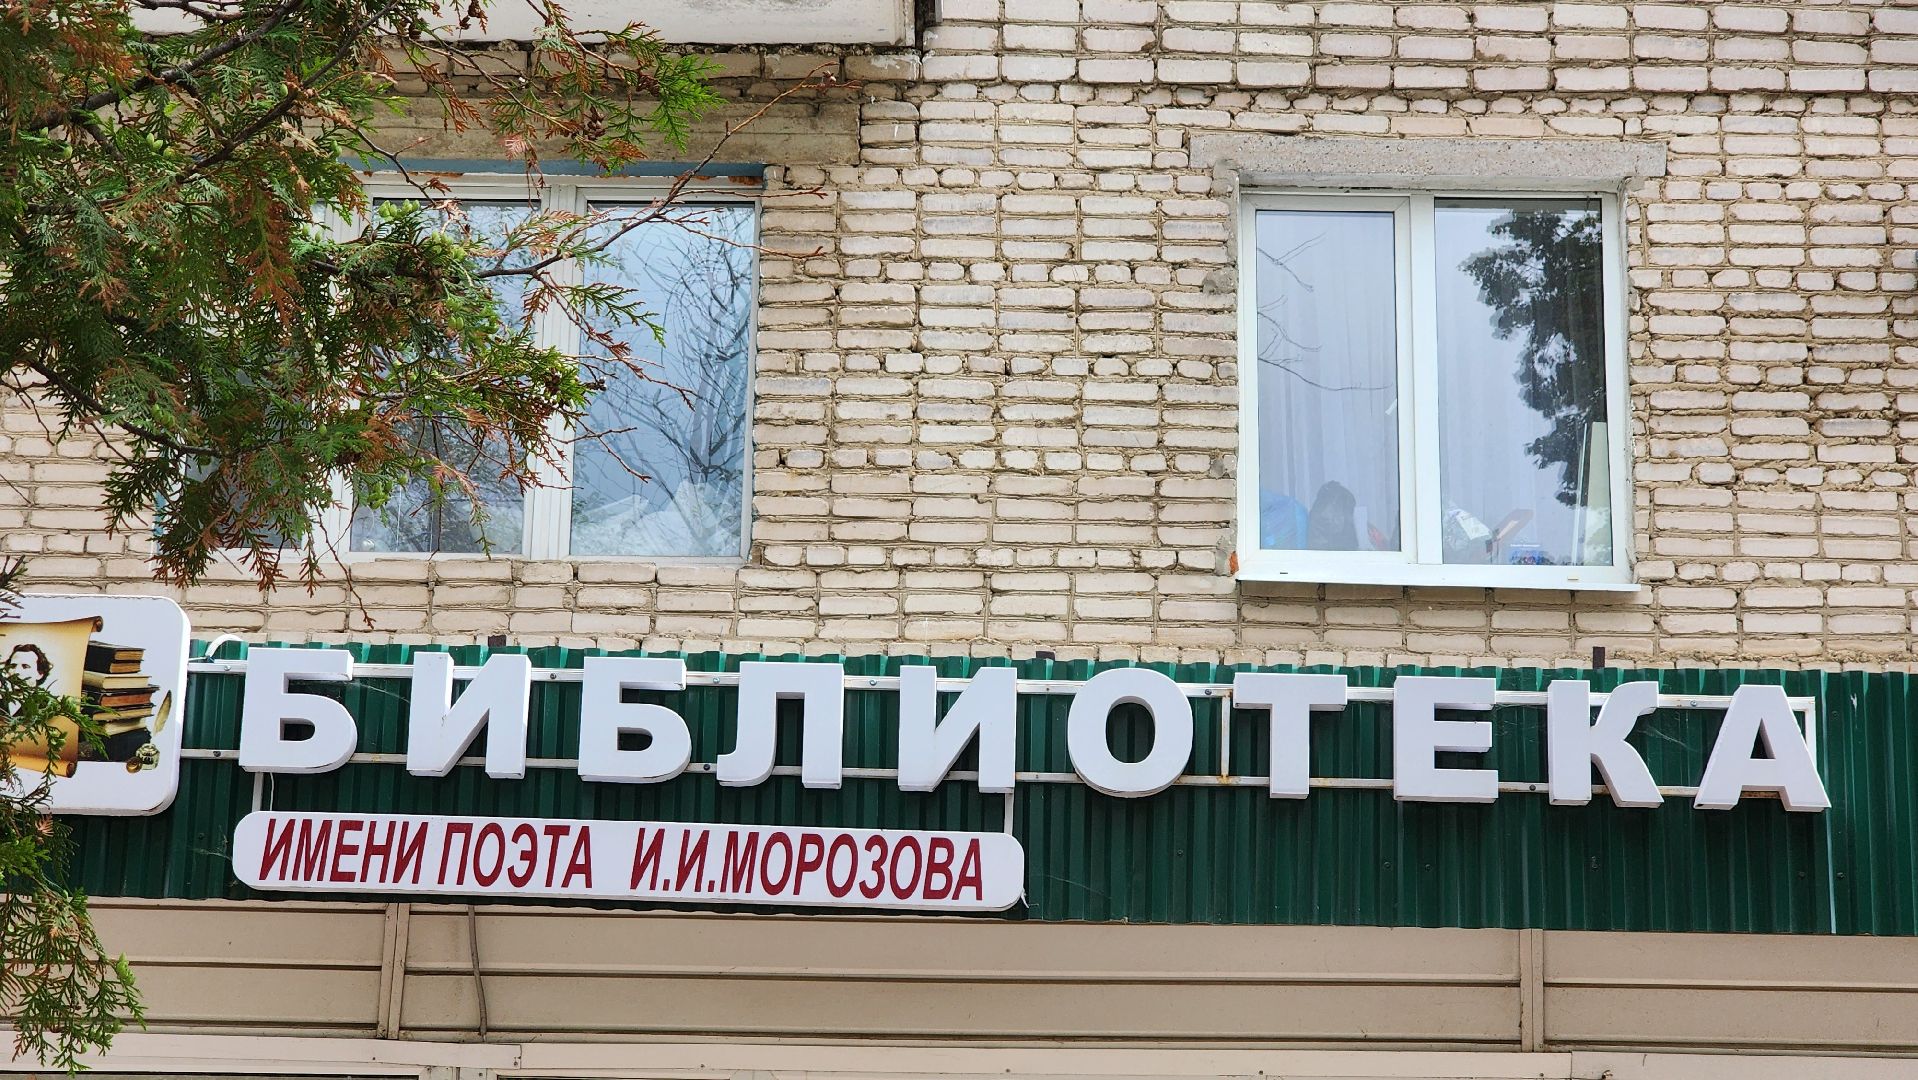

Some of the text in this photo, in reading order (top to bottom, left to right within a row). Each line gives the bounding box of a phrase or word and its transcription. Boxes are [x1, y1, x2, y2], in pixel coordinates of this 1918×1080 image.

[238, 647, 1831, 812] БИБЛИОТЕКА
[259, 819, 983, 900] ИМЕНИ ПОЭТА И.И.МОРОЗОВА
